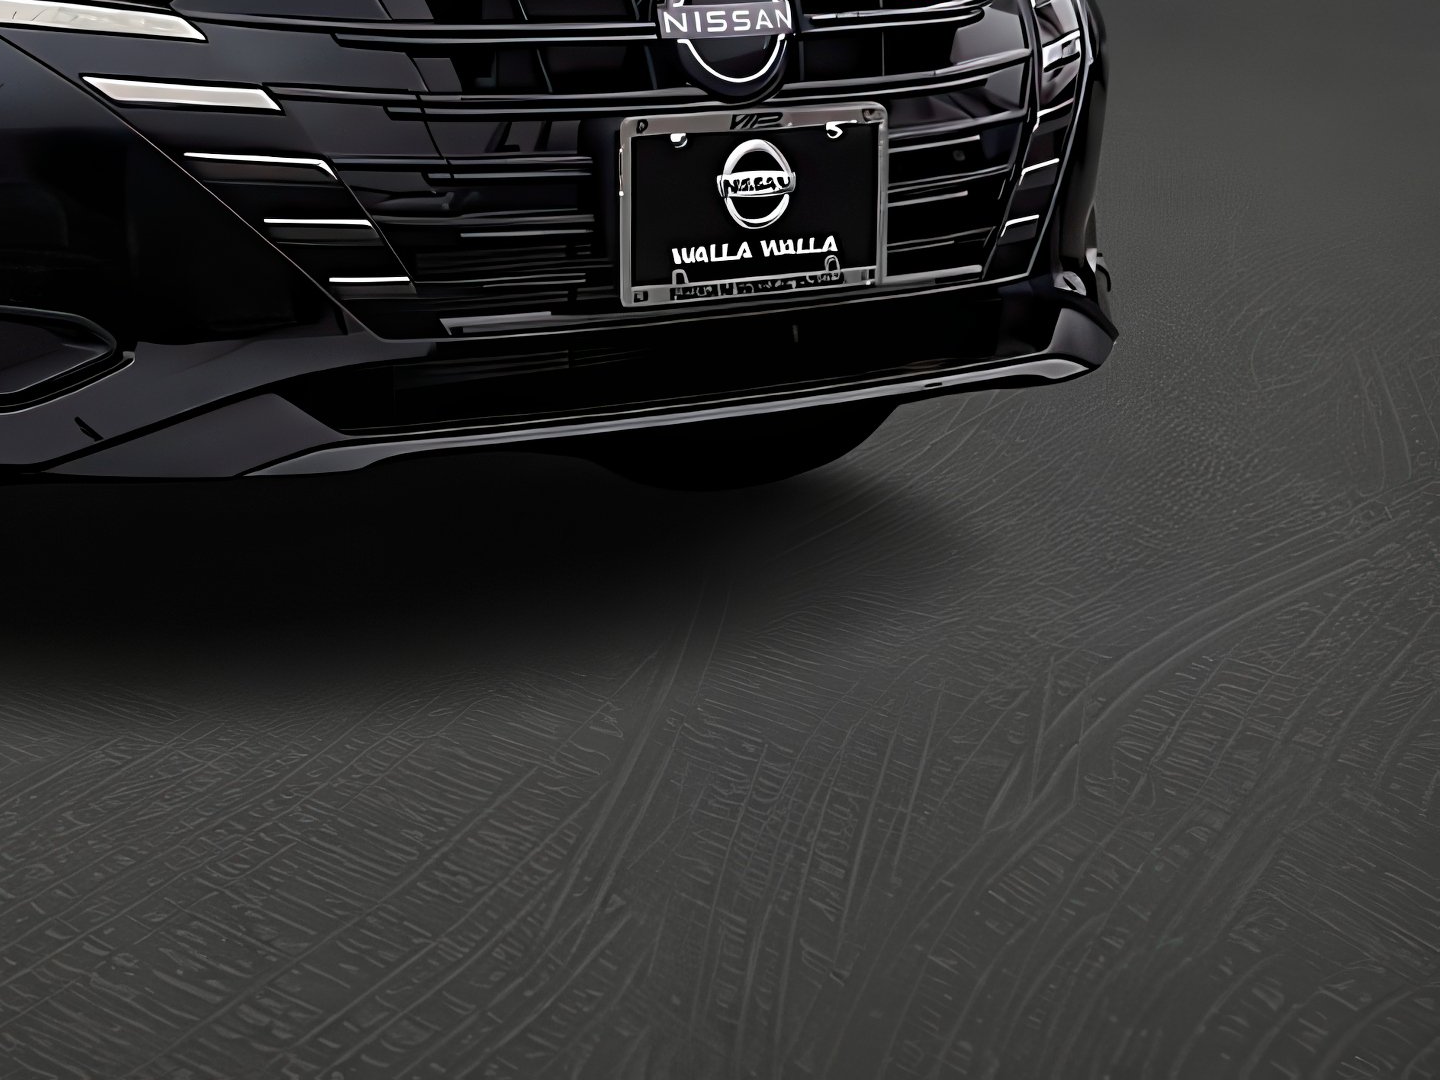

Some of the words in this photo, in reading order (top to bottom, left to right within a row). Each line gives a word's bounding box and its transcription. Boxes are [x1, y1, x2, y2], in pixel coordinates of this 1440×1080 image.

[663, 7, 792, 34] NISSAN
[671, 241, 752, 265] WALLA
[760, 235, 838, 257] WALLA
